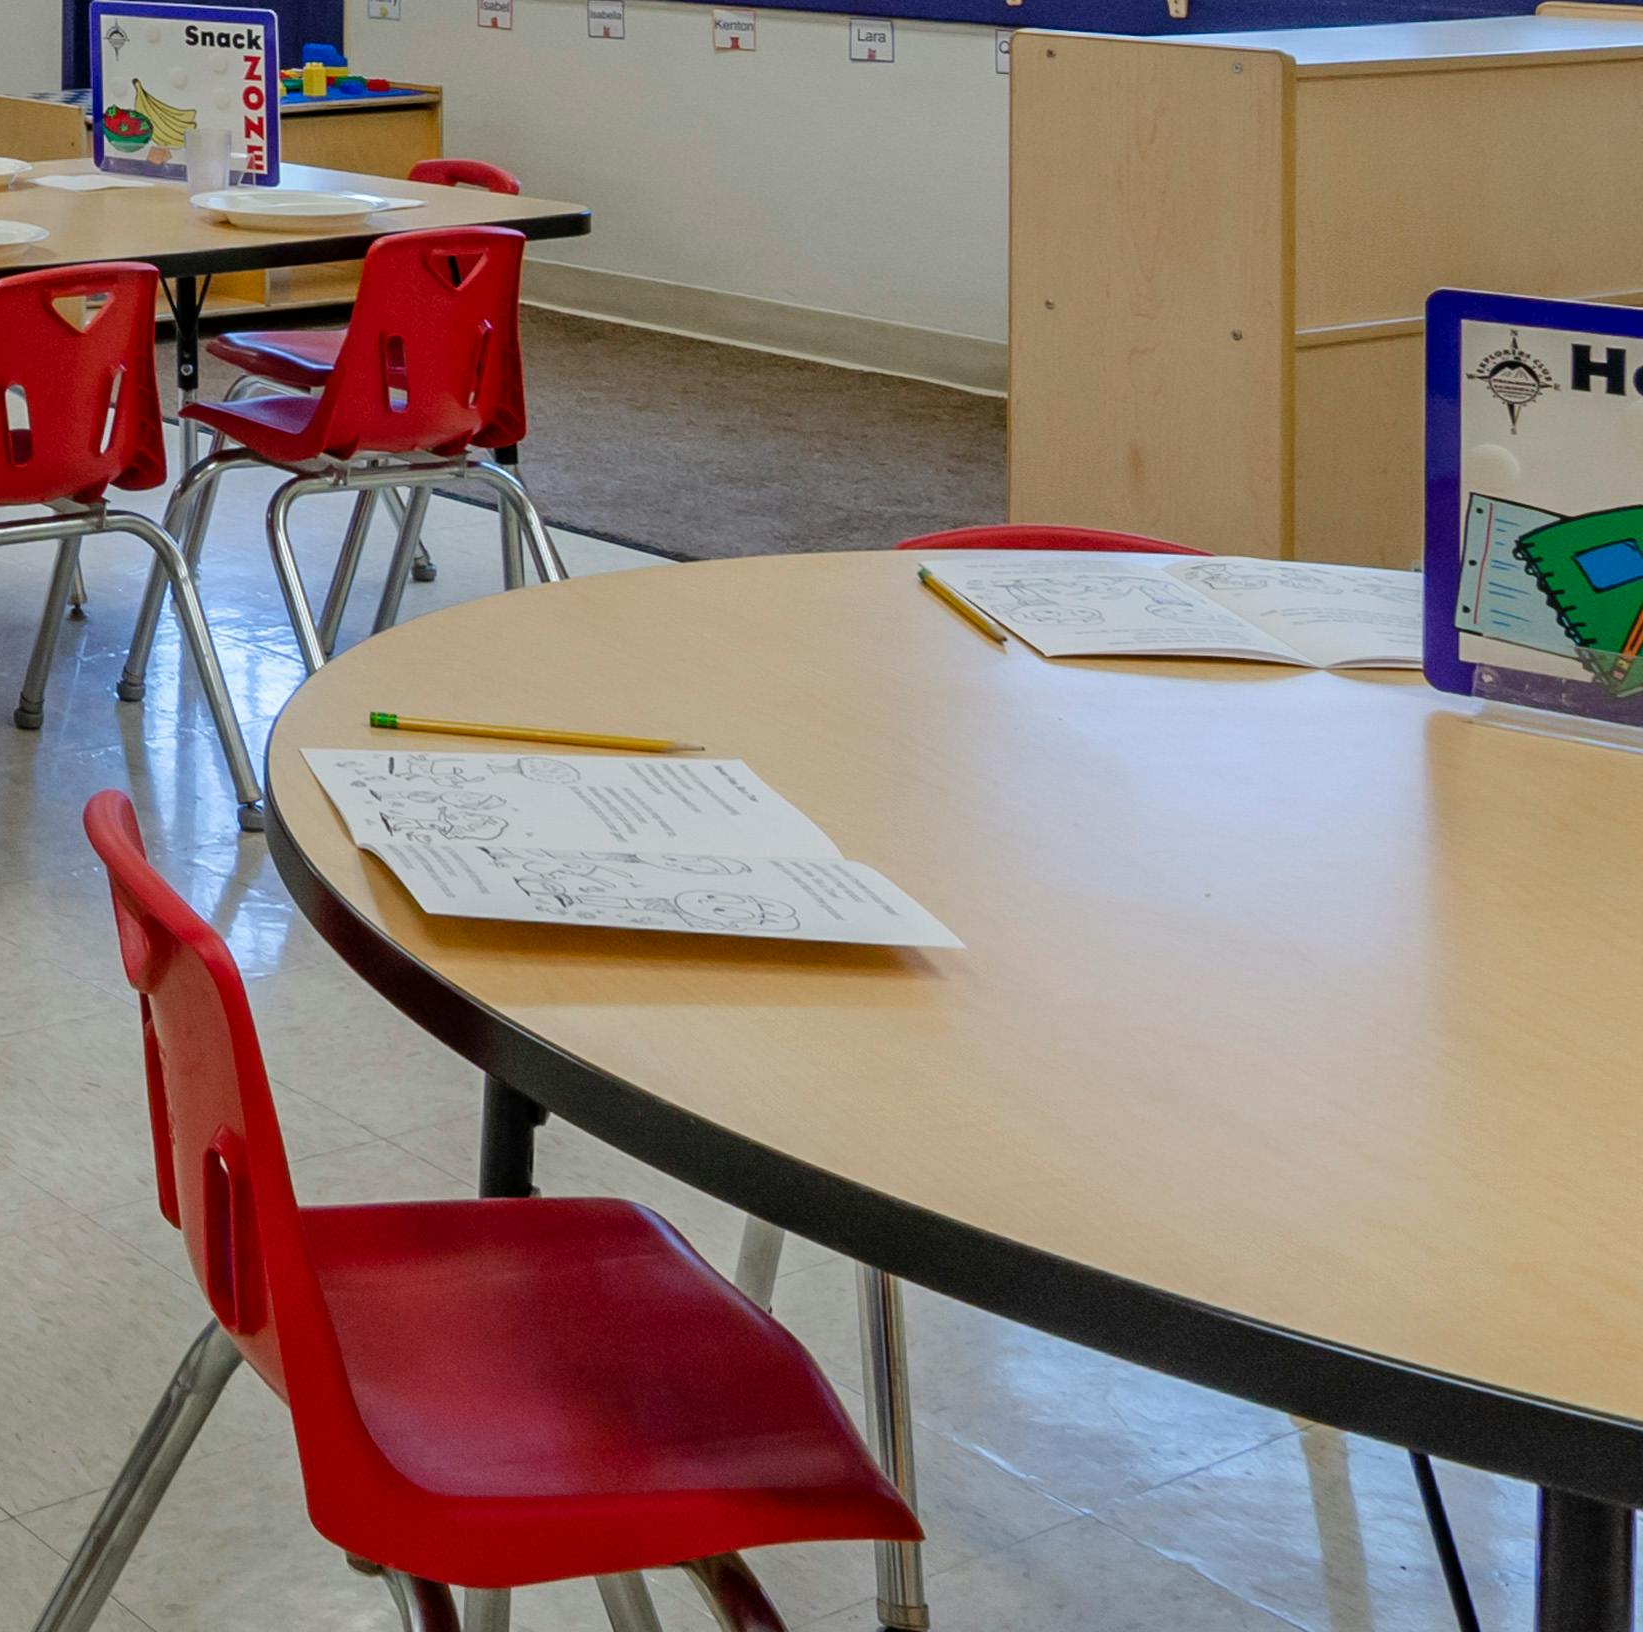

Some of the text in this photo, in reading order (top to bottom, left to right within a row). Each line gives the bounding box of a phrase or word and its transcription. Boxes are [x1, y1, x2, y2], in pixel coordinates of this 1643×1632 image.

[481, 0, 510, 12] Isabel
[715, 19, 754, 32] Kenton
[185, 25, 263, 50] Snack
[857, 29, 886, 44] Lara
[242, 55, 265, 171] ZONE
[1571, 343, 1643, 398] H
